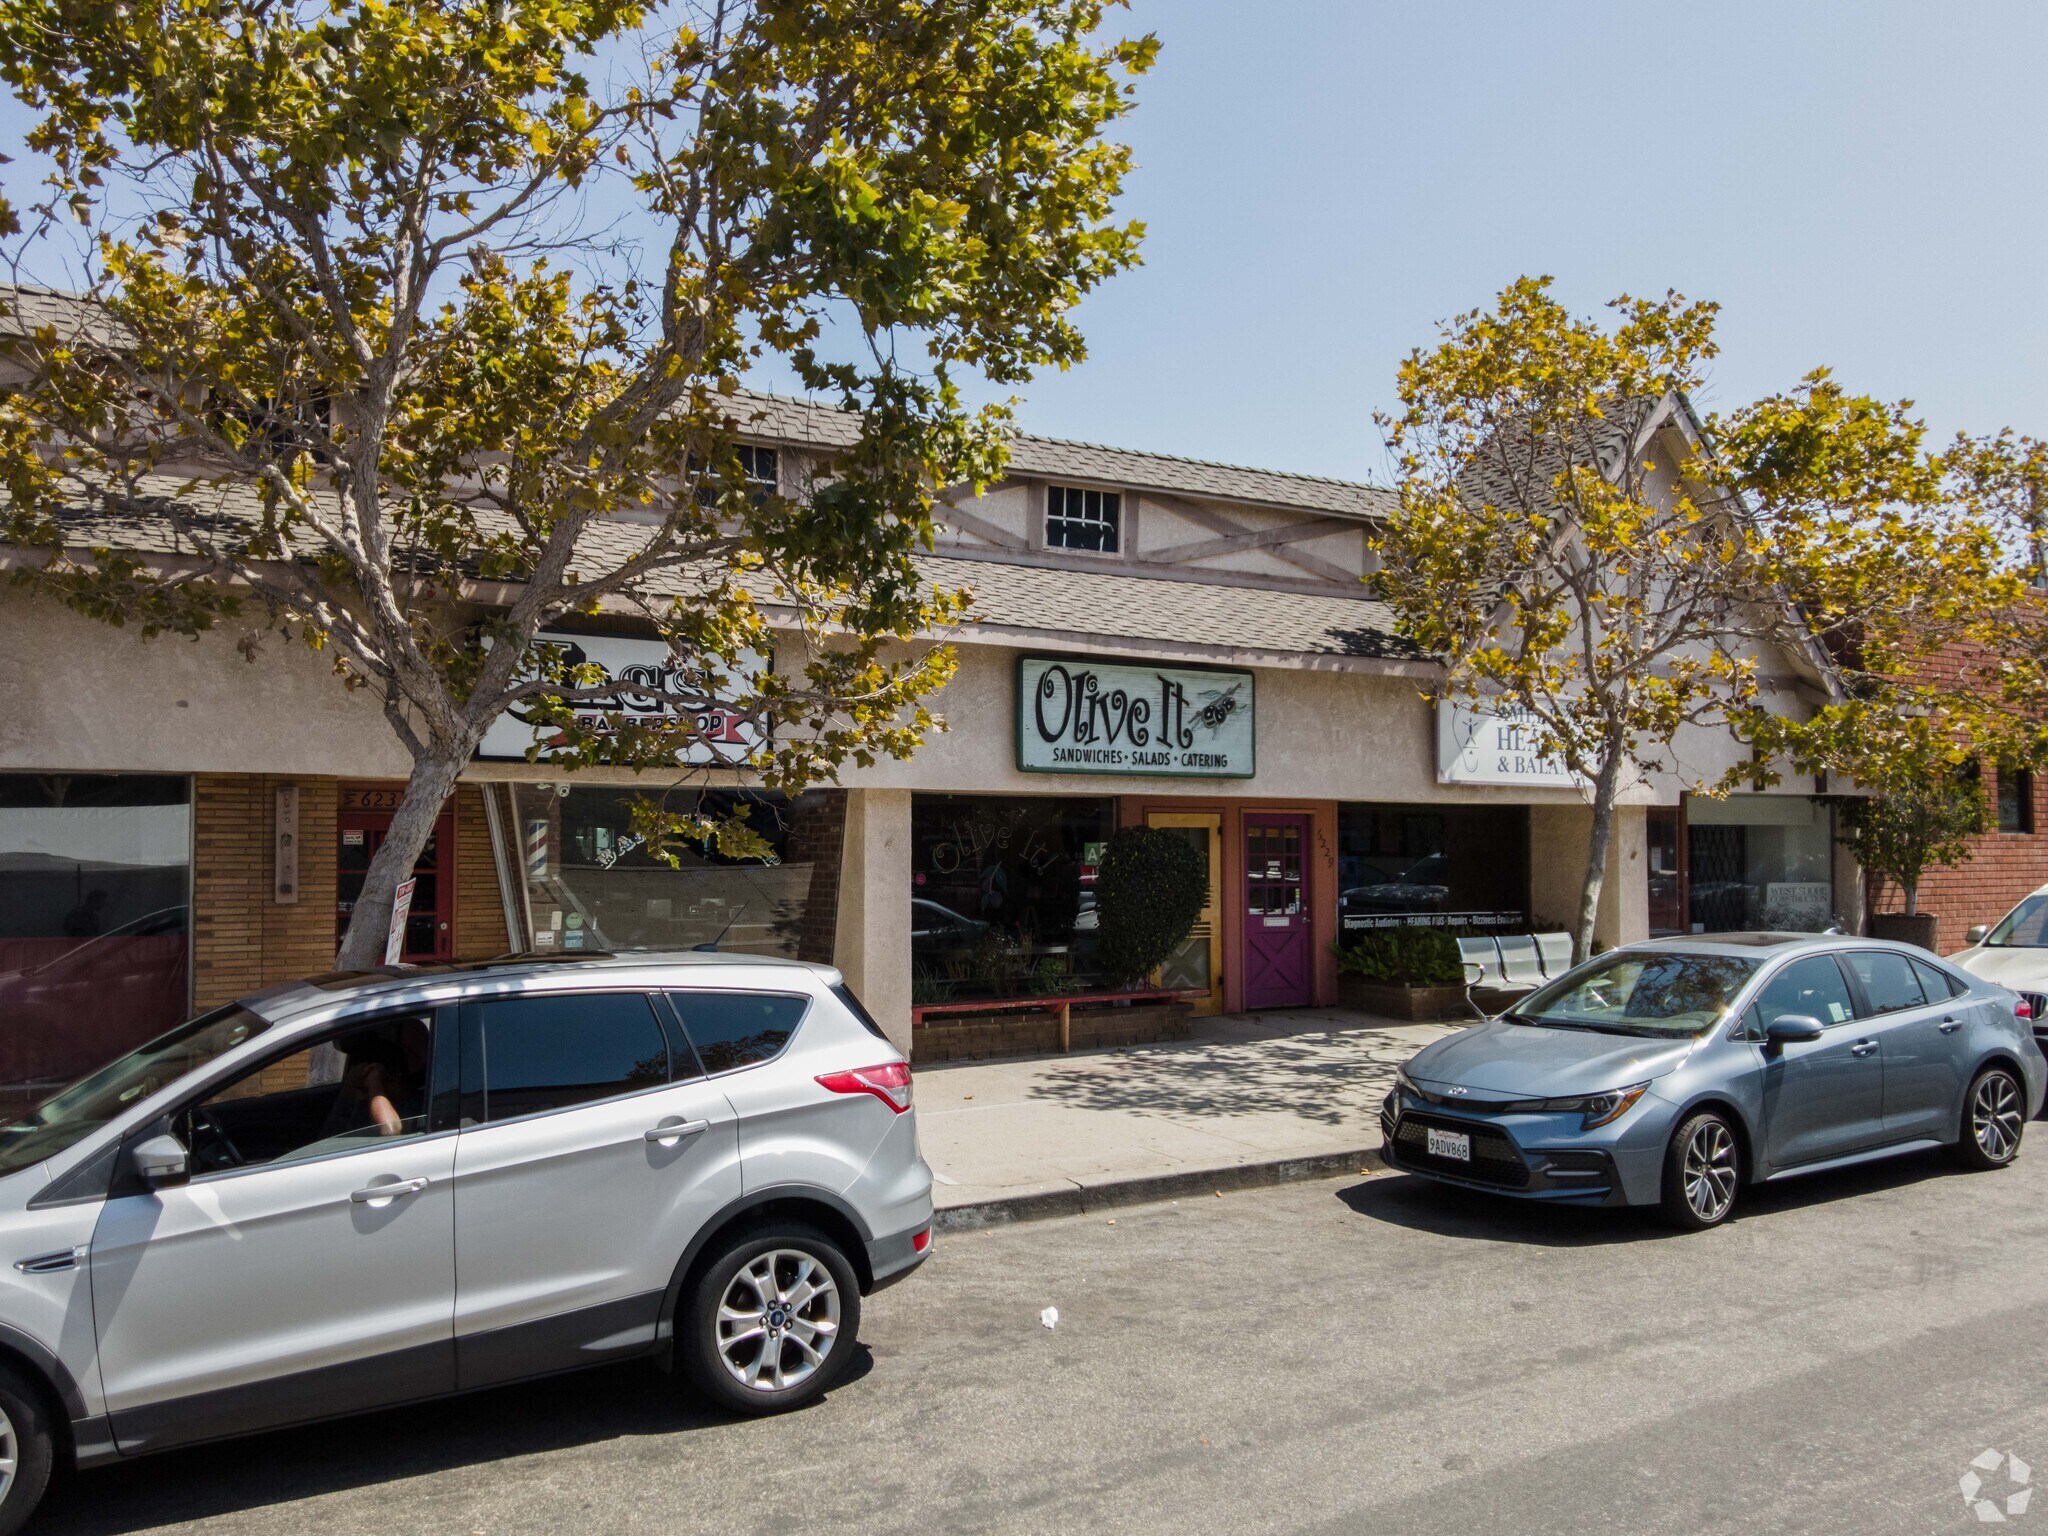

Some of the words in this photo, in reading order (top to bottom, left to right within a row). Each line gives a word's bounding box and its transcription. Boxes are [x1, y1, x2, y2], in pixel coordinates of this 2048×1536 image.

[1035, 664, 1151, 747] Olive
[1156, 673, 1193, 749] It
[1053, 747, 1123, 764] SANDWICHES
[1132, 750, 1171, 766] SALADS
[1181, 752, 1228, 768] CATERING
[1497, 755, 1510, 773] &
[1514, 756, 1583, 776] BALA
[361, 791, 398, 808] 623
[1087, 847, 1098, 861] A
[1344, 918, 1374, 929] Diagnostic
[1429, 1137, 1468, 1158] 9ADV868
